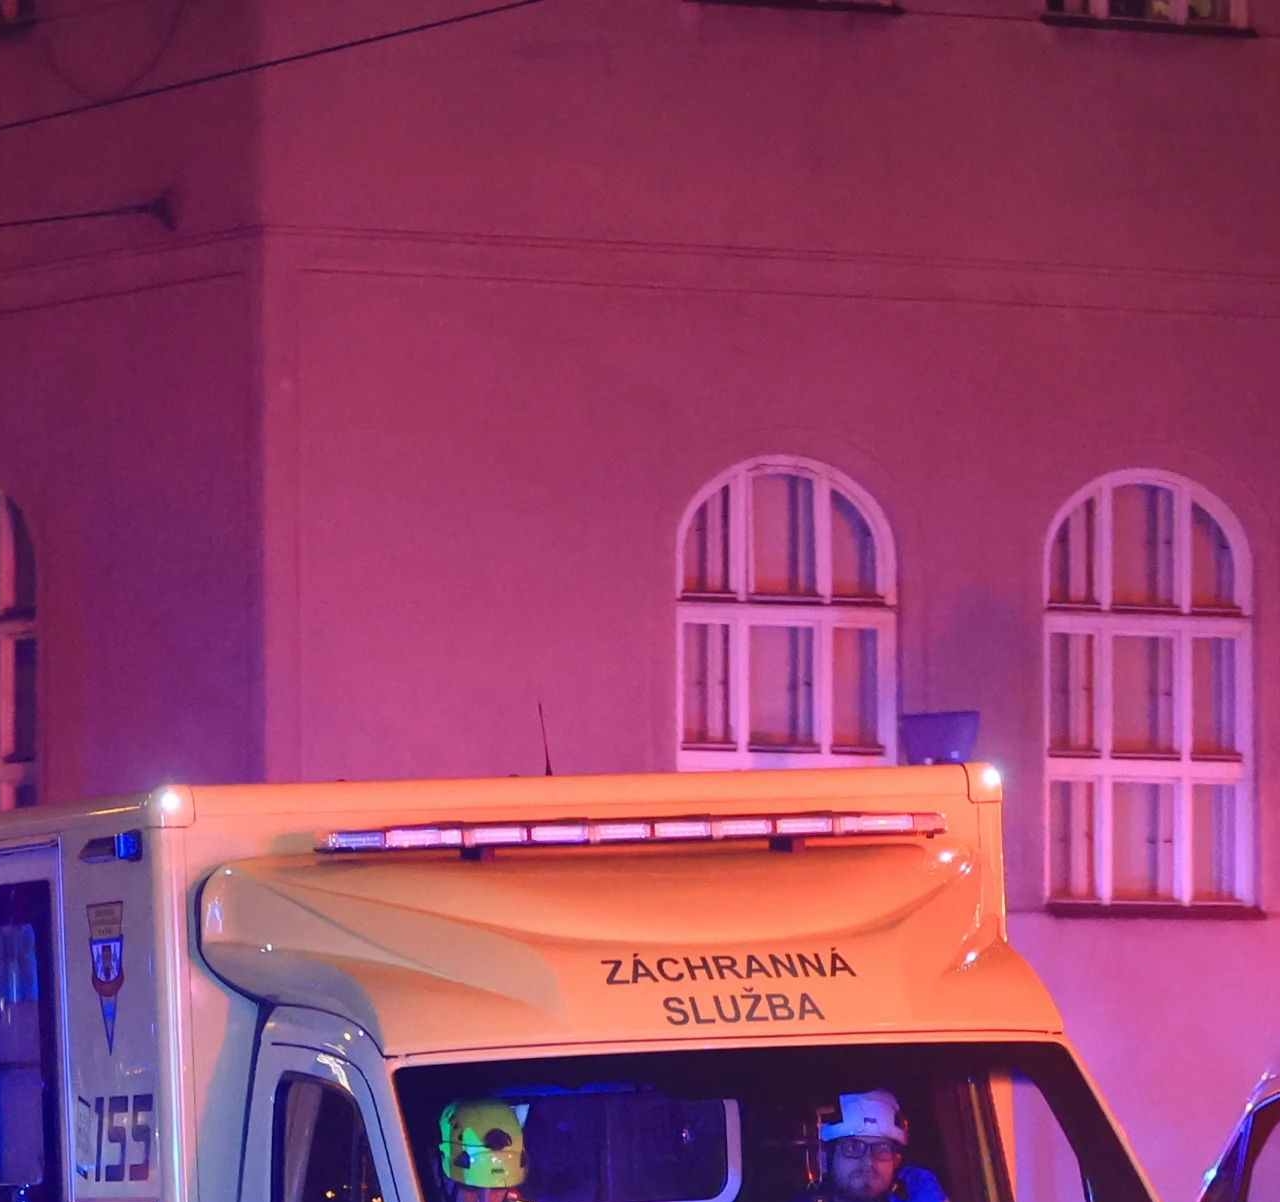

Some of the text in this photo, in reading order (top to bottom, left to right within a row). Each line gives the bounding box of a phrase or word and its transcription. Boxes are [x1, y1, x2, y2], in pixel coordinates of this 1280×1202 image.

[601, 947, 857, 985] ZÁCHRANNÁ
[662, 986, 826, 1026] SLUŽBA
[94, 1093, 154, 1182] 155
